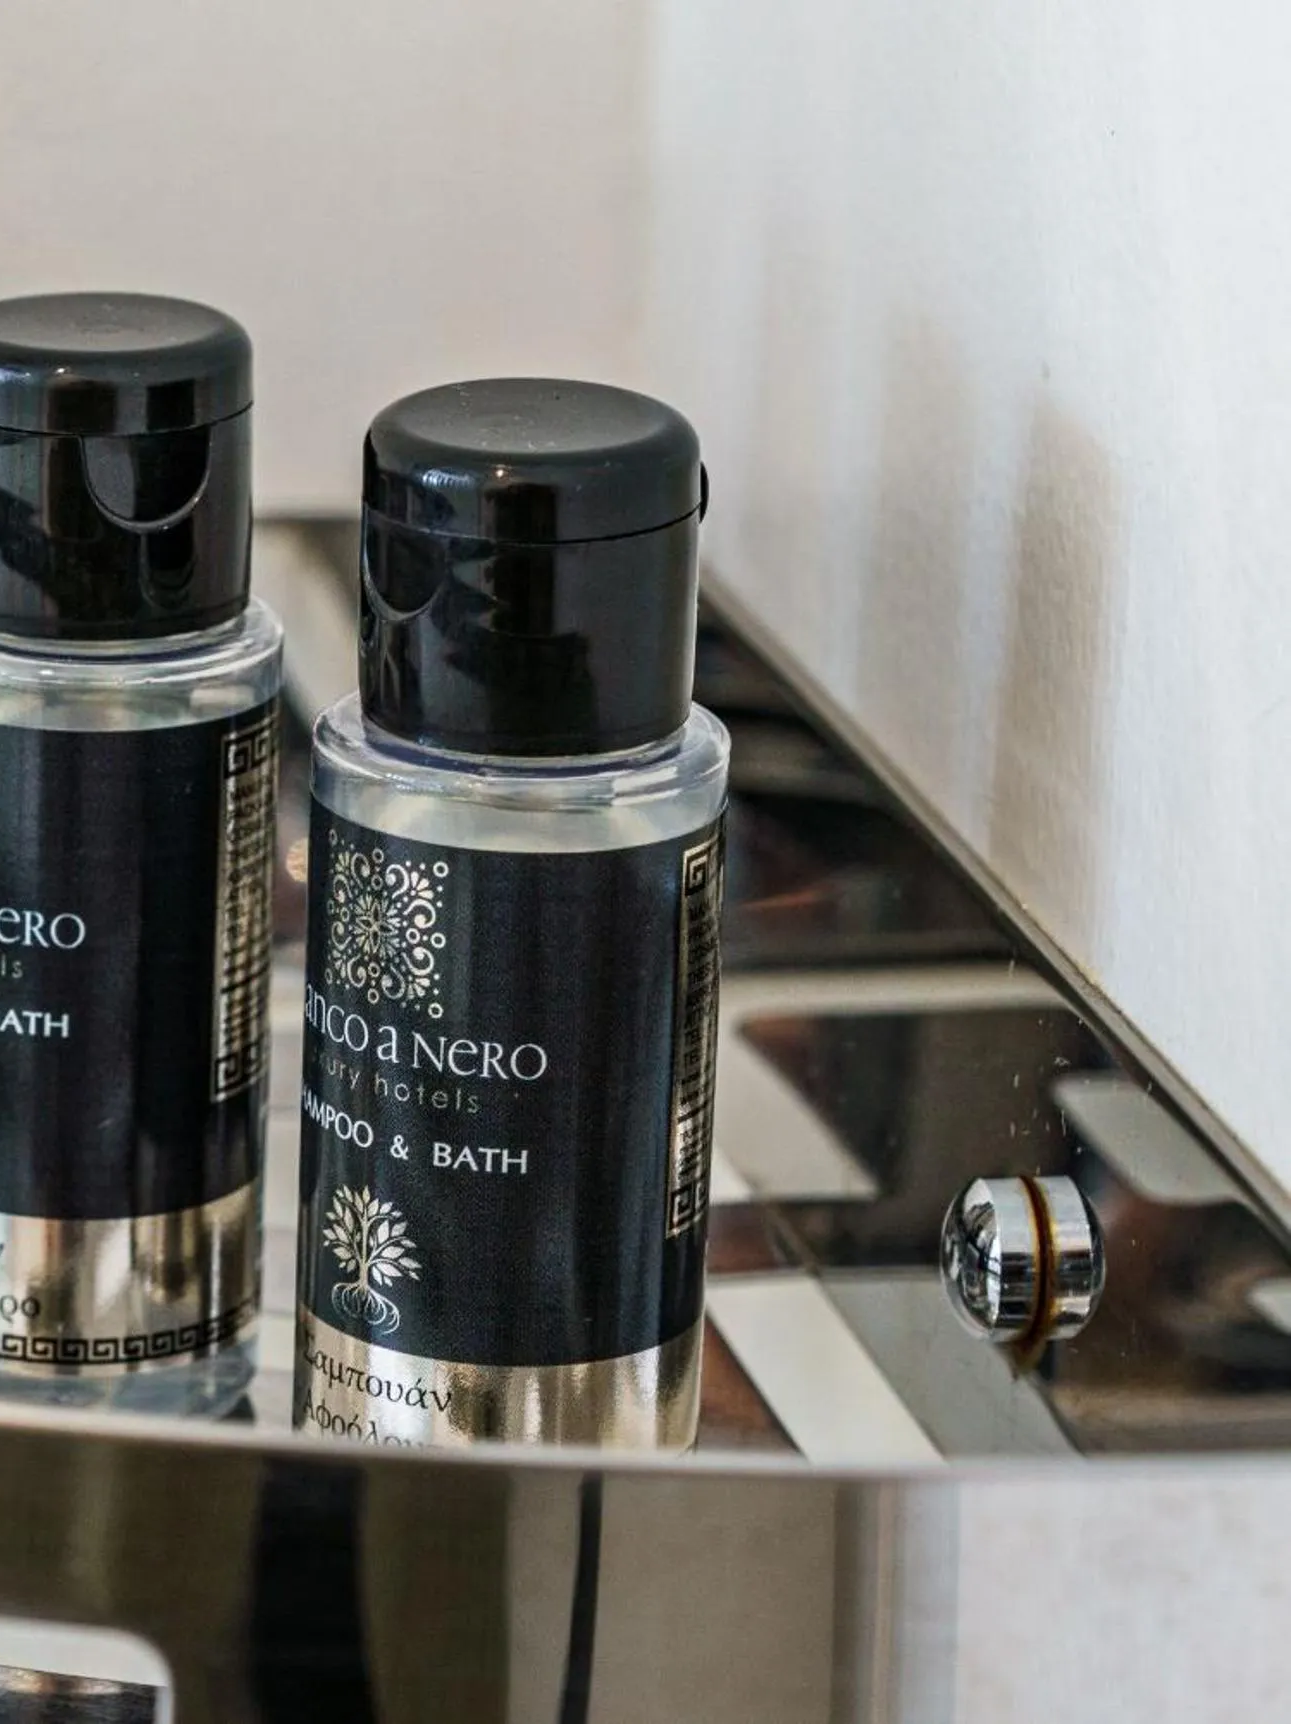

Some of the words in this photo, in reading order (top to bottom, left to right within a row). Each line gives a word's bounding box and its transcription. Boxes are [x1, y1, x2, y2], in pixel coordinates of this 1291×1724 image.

[376, 1025, 400, 1064] a
[375, 1073, 481, 1114] hotels
[302, 1083, 374, 1148] AMPOO
[389, 1134, 409, 1160] &
[432, 1142, 529, 1175] BATH
